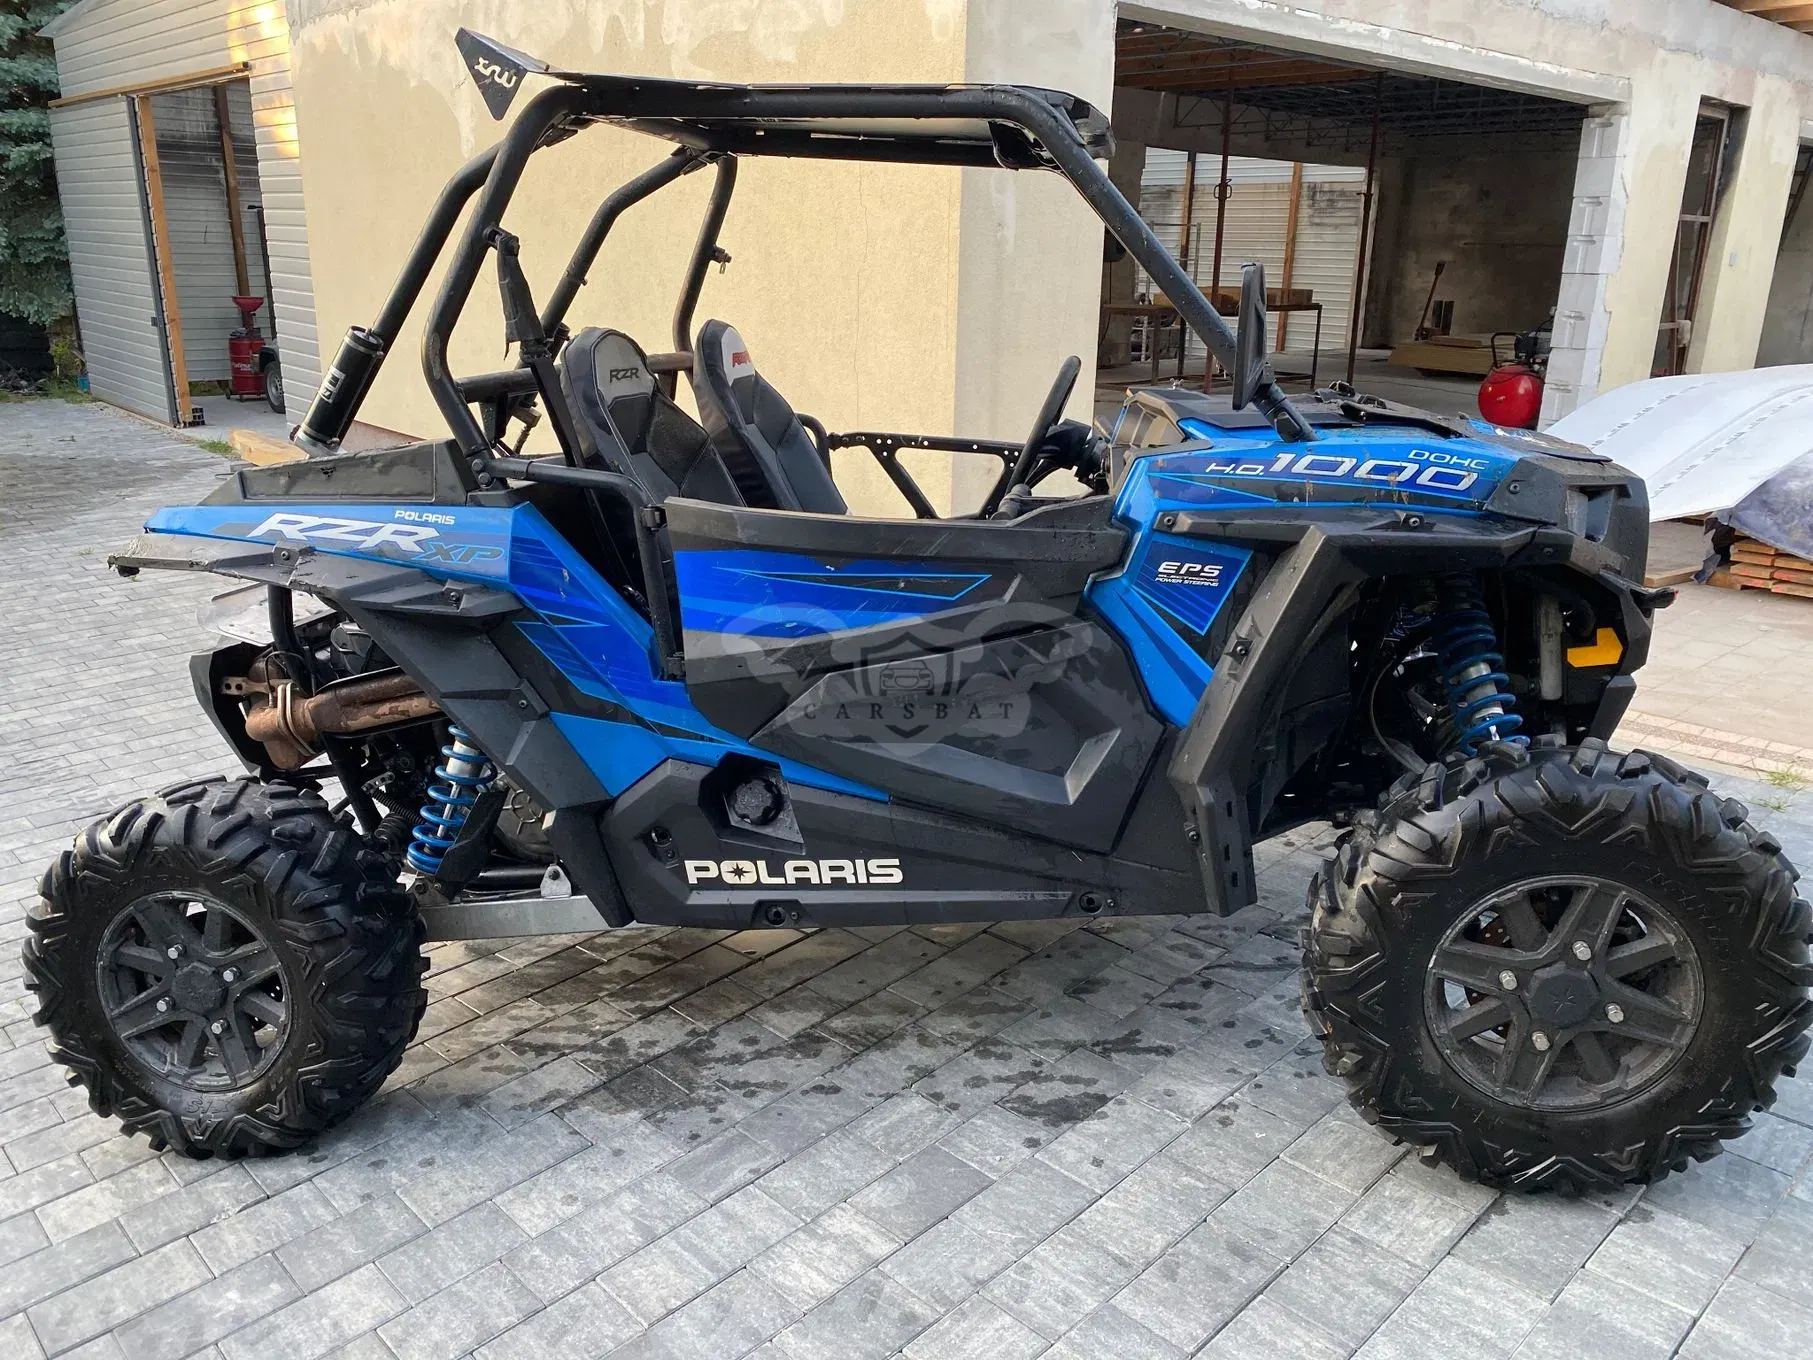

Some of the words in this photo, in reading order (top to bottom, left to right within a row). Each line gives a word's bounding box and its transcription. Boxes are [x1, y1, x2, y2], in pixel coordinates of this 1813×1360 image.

[609, 368, 640, 383] RZR
[1407, 449, 1489, 470] DOHC
[1205, 462, 1265, 476] H.O.
[1269, 453, 1479, 491] 1000
[394, 510, 456, 525] POLARIS
[247, 513, 440, 552] RZR
[411, 542, 504, 564] XP
[1158, 561, 1223, 577] EPS
[684, 858, 903, 884] POLARIS
